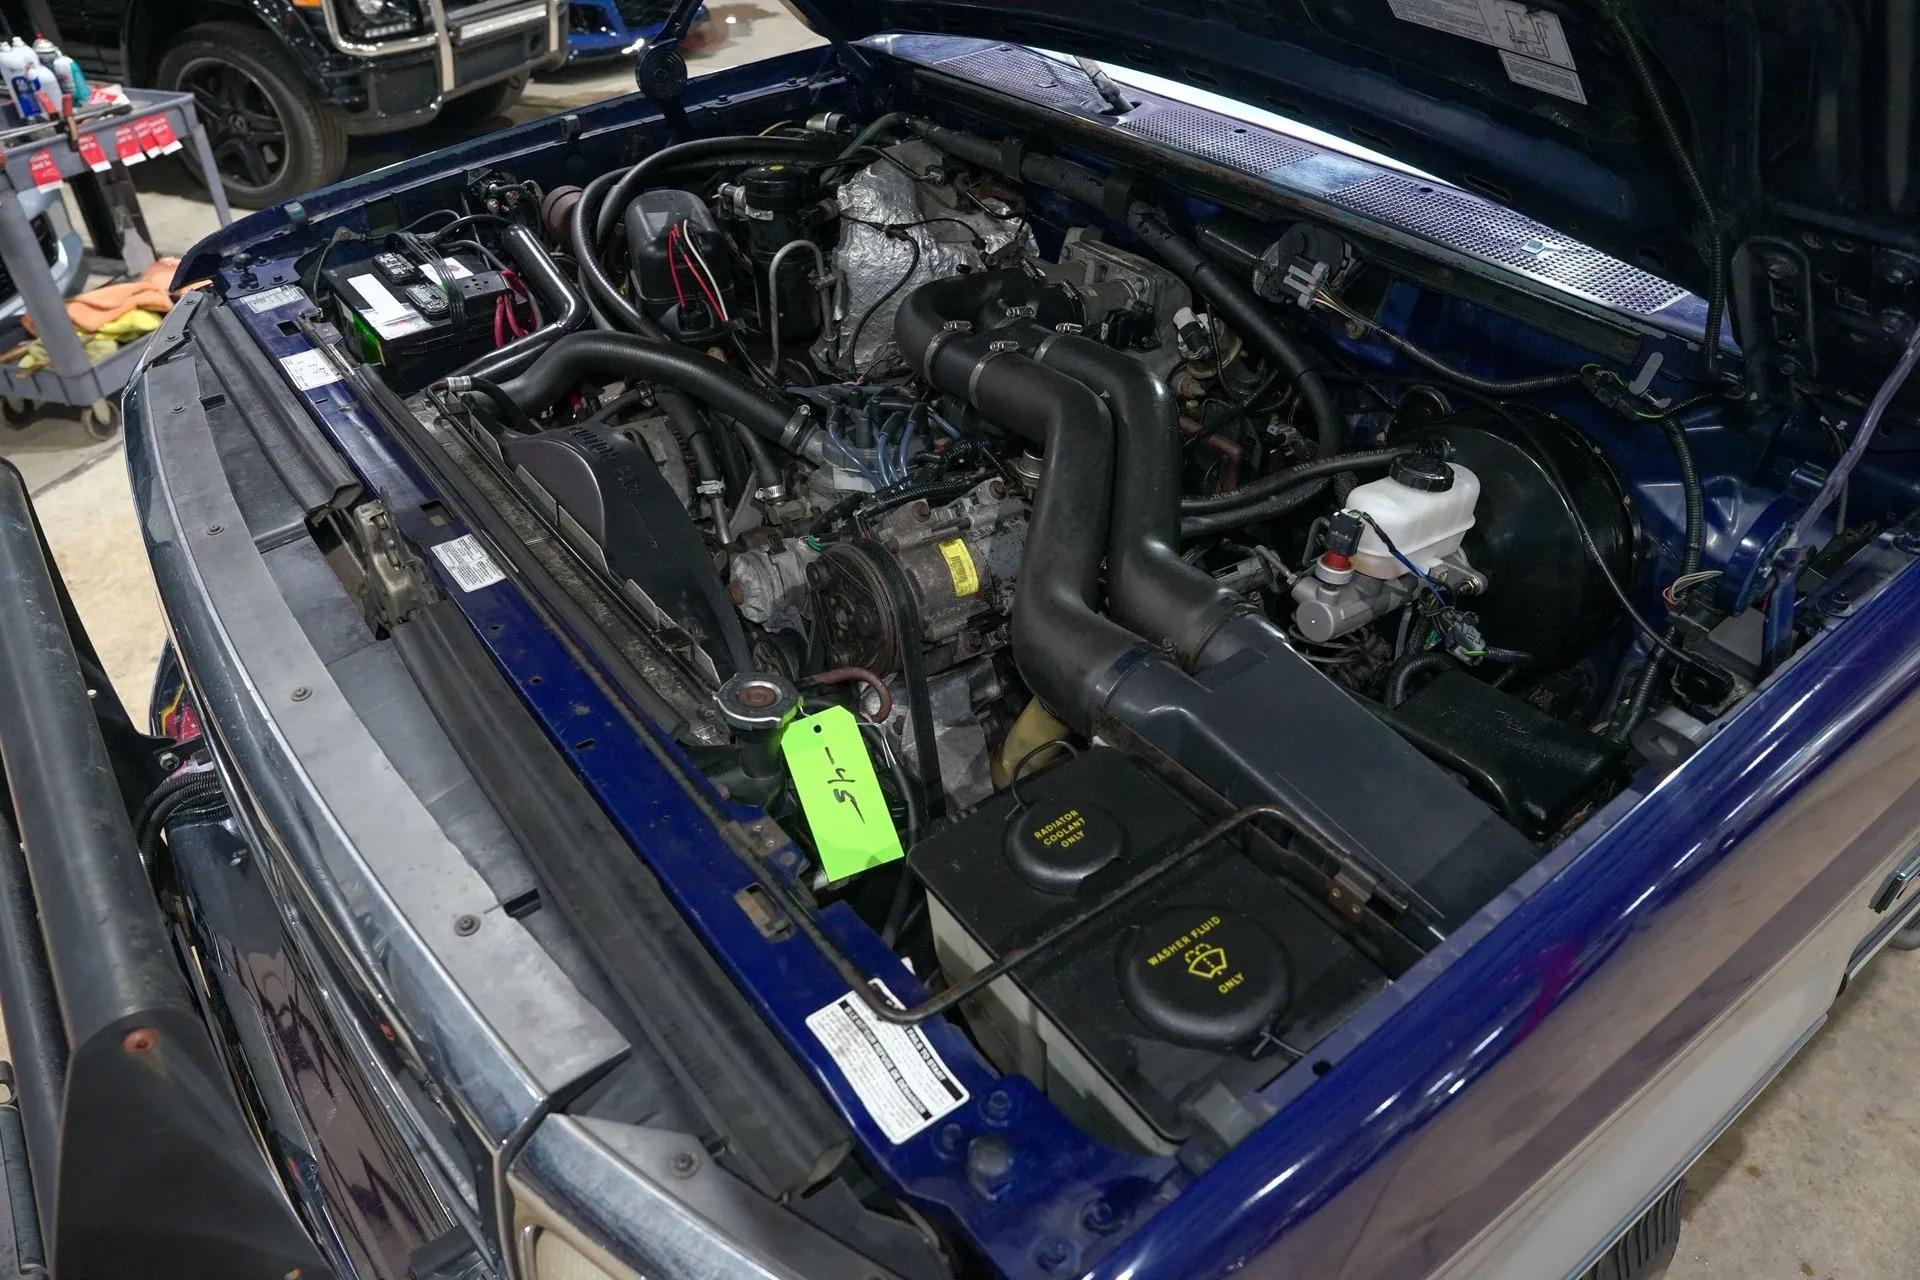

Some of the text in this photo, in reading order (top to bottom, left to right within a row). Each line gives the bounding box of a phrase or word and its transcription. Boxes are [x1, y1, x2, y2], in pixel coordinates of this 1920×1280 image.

[1034, 810, 1078, 839] RADIATOR
[1043, 817, 1085, 845] COOLANT
[1061, 831, 1085, 847] ONLY
[1147, 916, 1220, 966] WASHER FLUID
[1218, 972, 1244, 994] ONLY
